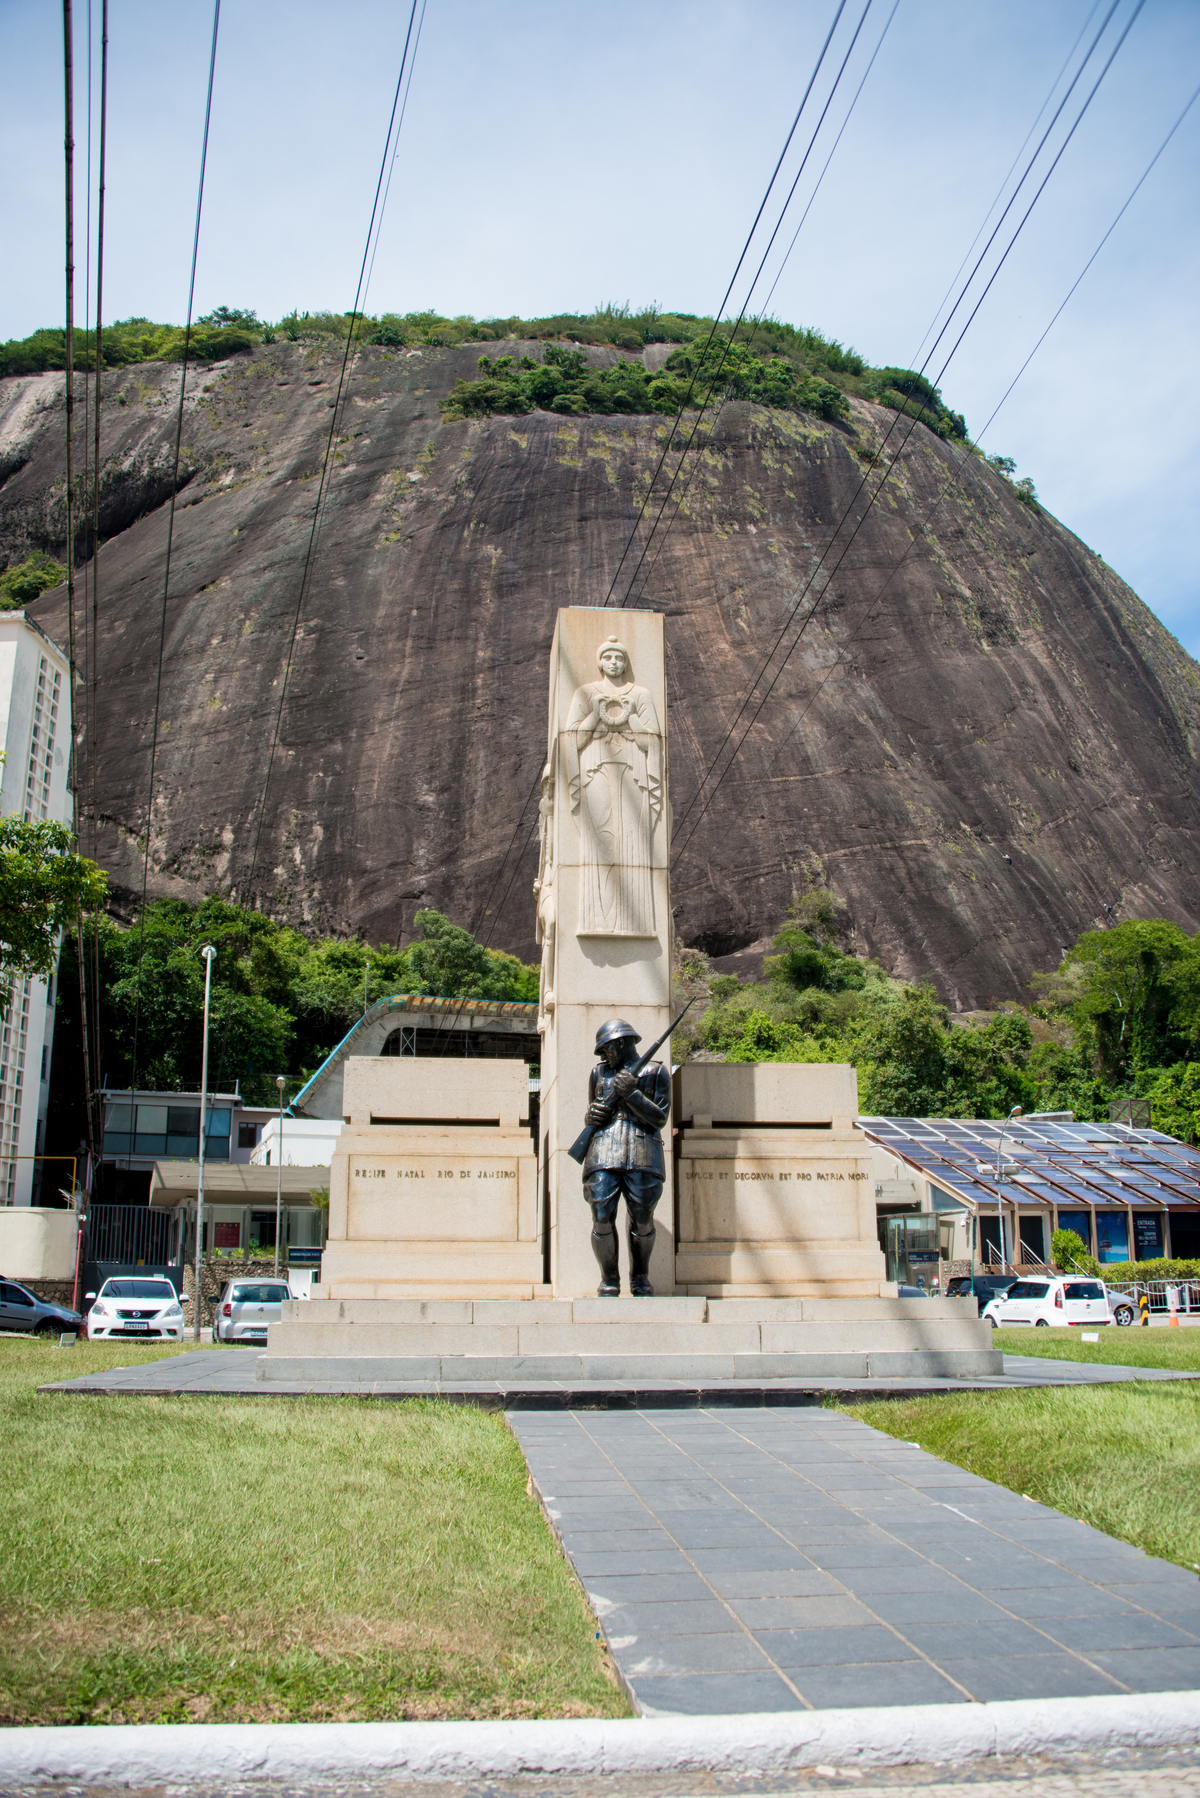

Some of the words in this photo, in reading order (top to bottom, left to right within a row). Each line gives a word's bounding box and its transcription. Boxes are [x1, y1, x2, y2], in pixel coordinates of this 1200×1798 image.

[355, 1169, 386, 1178] RECIFE
[397, 1170, 425, 1179] NATAL
[437, 1170, 454, 1179] RIO
[459, 1170, 471, 1179] DE
[477, 1170, 516, 1179] JANEIRO
[685, 1172, 714, 1180] DVLCE
[719, 1172, 729, 1180] ET
[734, 1172, 775, 1181] DECORVM
[779, 1172, 792, 1181] EST
[796, 1172, 812, 1181] PRO
[816, 1172, 845, 1181] PATRIA
[848, 1172, 869, 1181] MORI
